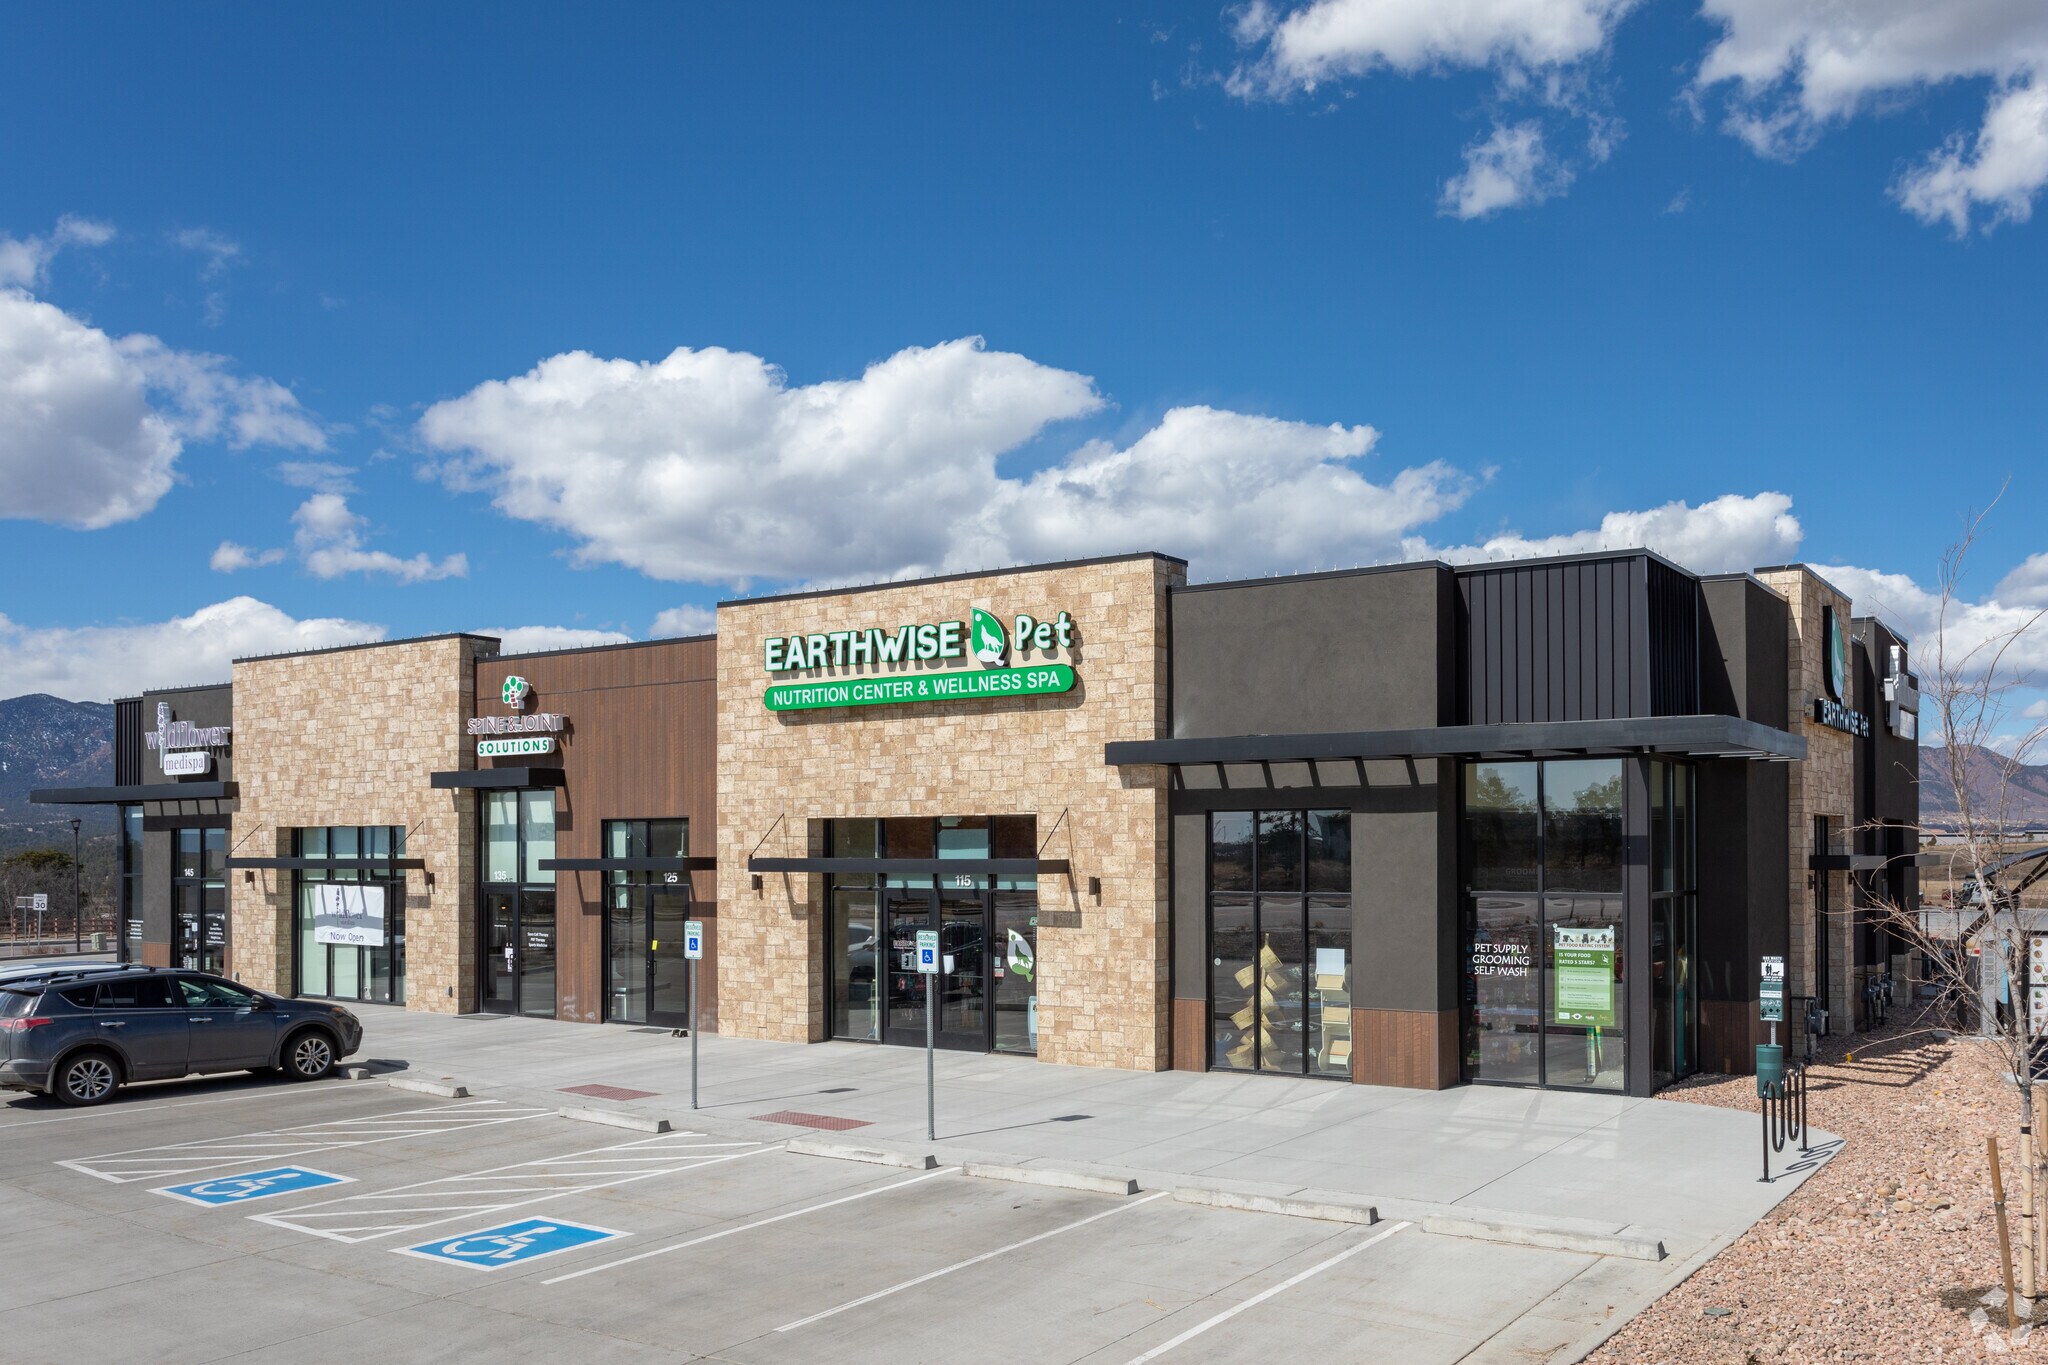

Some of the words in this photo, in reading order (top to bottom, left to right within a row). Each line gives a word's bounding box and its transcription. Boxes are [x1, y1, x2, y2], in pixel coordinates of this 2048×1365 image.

[764, 620, 963, 672] EARTHWISE
[1014, 610, 1072, 651] Pet
[773, 686, 849, 706] NUTRITION
[852, 680, 914, 700] CENTER
[918, 680, 929, 696] &
[933, 672, 1022, 695] WELLNESS
[1026, 670, 1061, 688] SPA
[467, 716, 503, 735] SPINE
[507, 715, 517, 733] &
[518, 713, 560, 732] JOINT
[479, 739, 548, 754] SOLUTIONS
[165, 755, 204, 771] medispa
[184, 868, 195, 877] 145
[494, 870, 507, 881] 135
[663, 872, 678, 883] 125
[955, 874, 971, 887] 115
[331, 932, 346, 941] Now
[348, 932, 364, 942] Open
[1474, 943, 1492, 952] PET
[1493, 944, 1528, 954] SUPPLY
[1472, 954, 1530, 965] GROOMING
[1474, 966, 1495, 975] SELF
[1497, 966, 1527, 977] WASH
